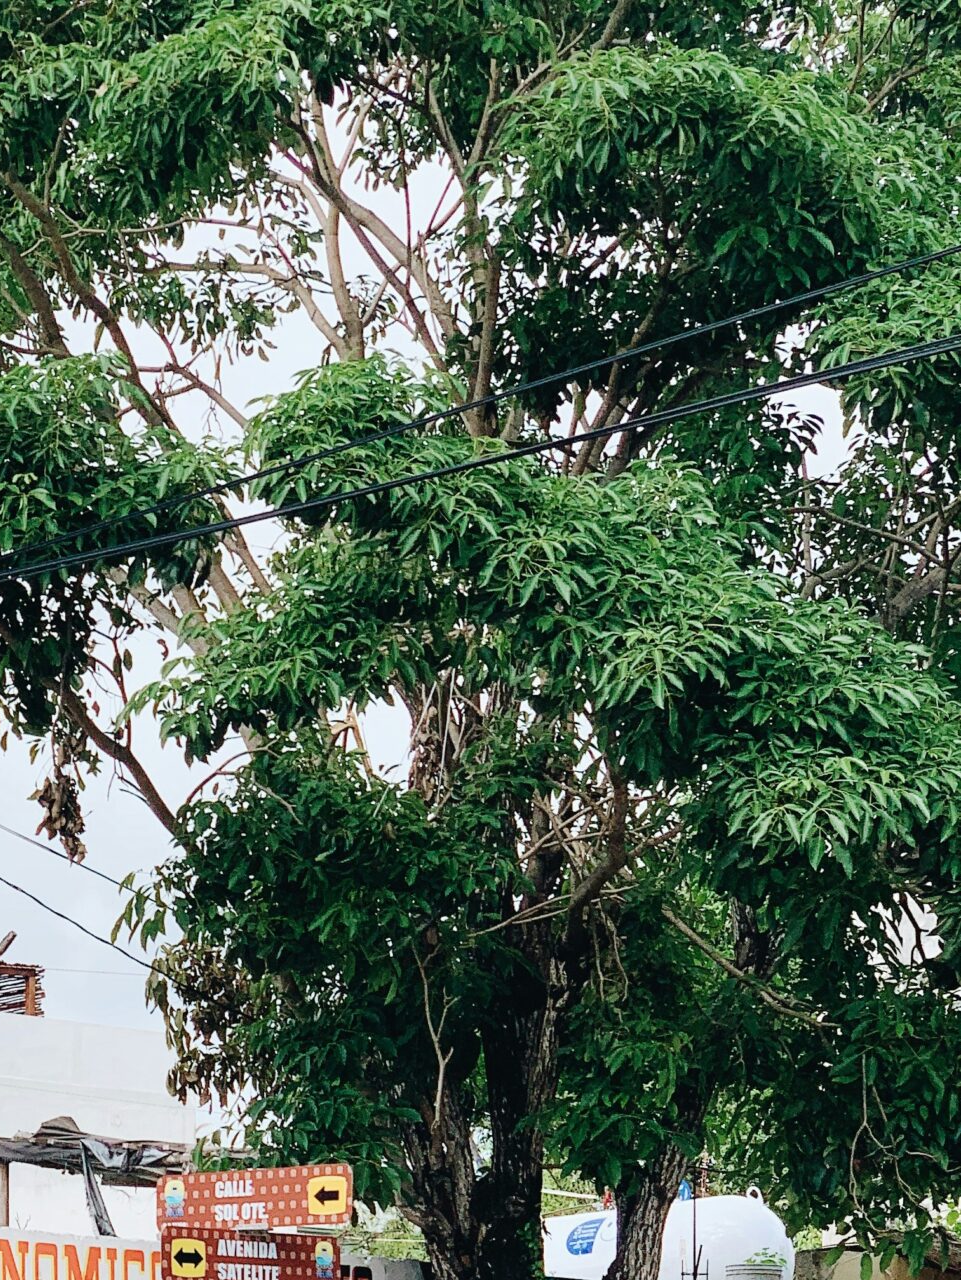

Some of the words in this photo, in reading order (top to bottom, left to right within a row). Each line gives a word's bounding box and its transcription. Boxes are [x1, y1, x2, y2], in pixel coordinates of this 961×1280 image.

[215, 1179, 254, 1198] CALLE
[214, 1204, 239, 1221] SOL
[217, 1240, 278, 1259] AVENIDA
